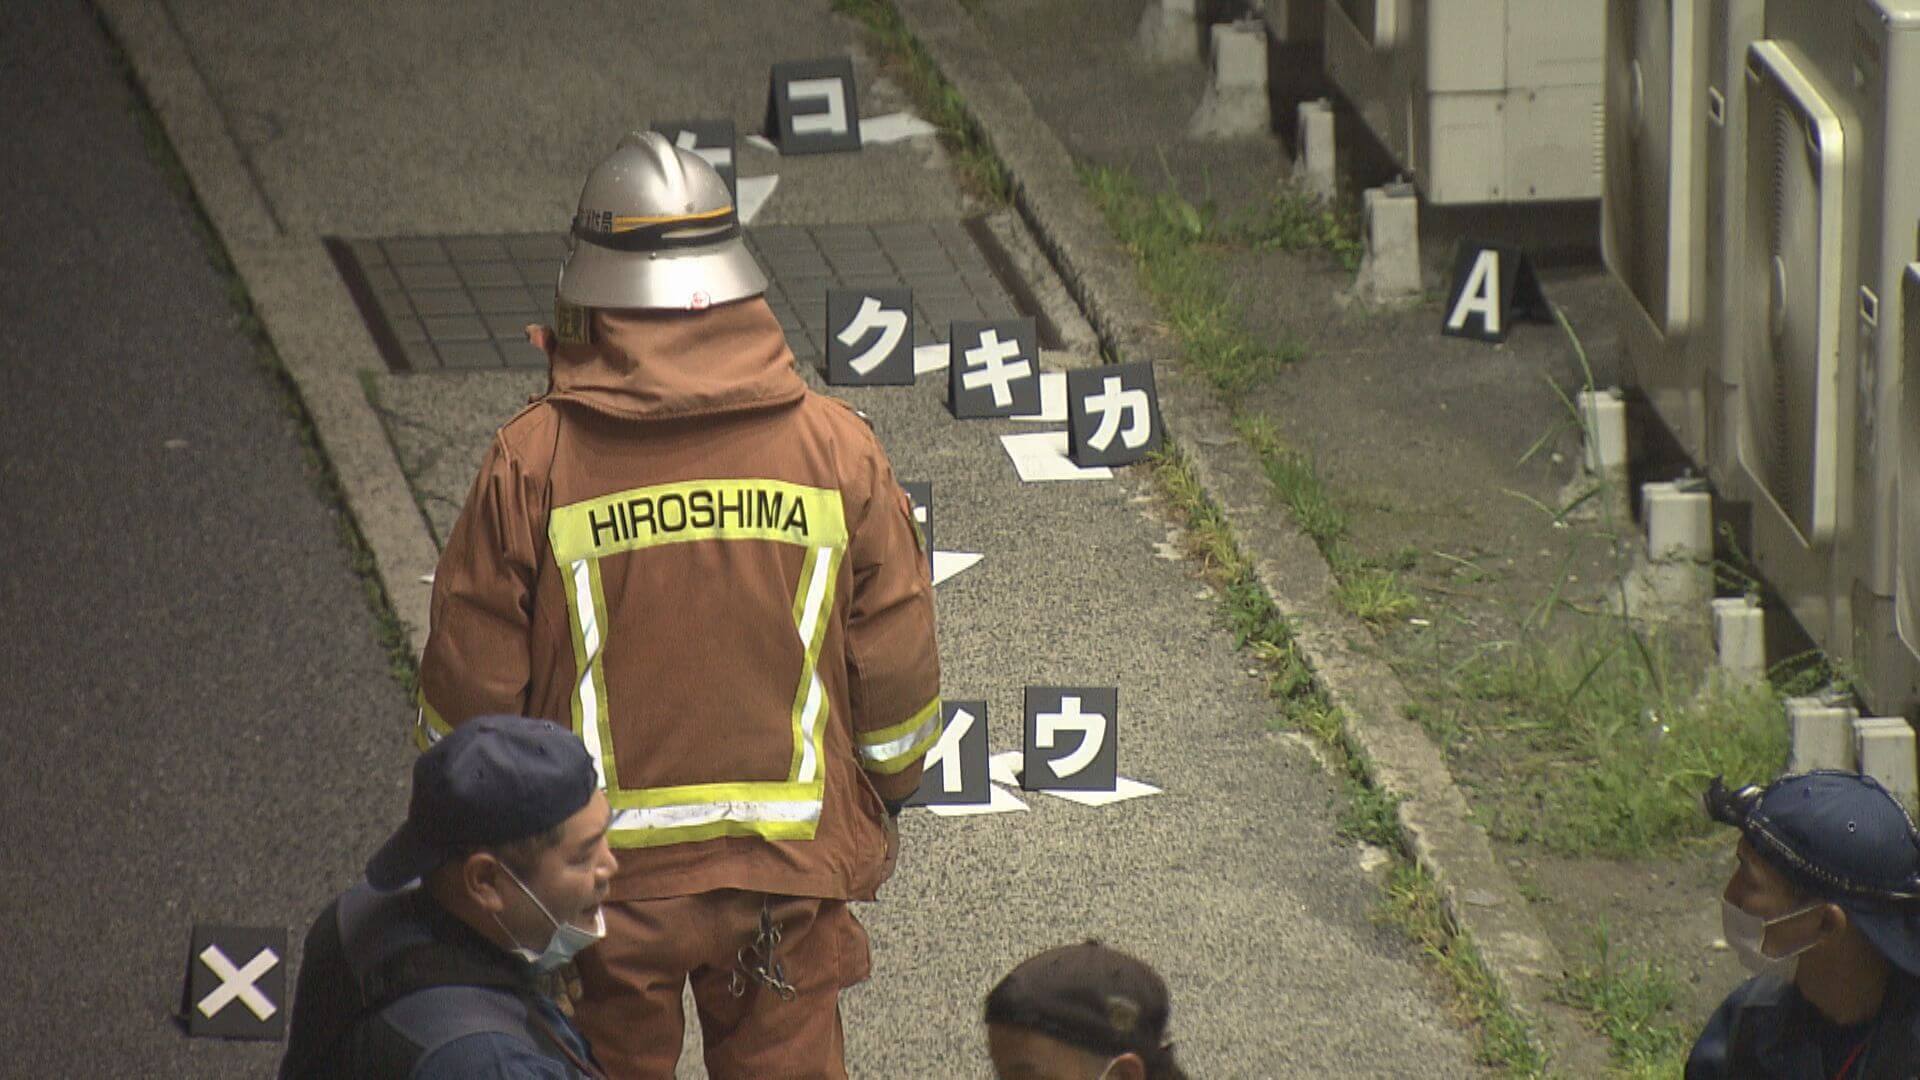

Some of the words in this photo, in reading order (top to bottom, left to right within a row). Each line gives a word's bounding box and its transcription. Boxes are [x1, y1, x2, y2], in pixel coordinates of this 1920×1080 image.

[788, 77, 848, 134] コ
[1448, 249, 1500, 333] A
[837, 297, 908, 376] ク
[962, 329, 1032, 408] キ
[1084, 376, 1151, 452] カ
[588, 488, 809, 547] HIROSHIMA
[922, 707, 975, 793] イ
[1035, 696, 1107, 779] ウ
